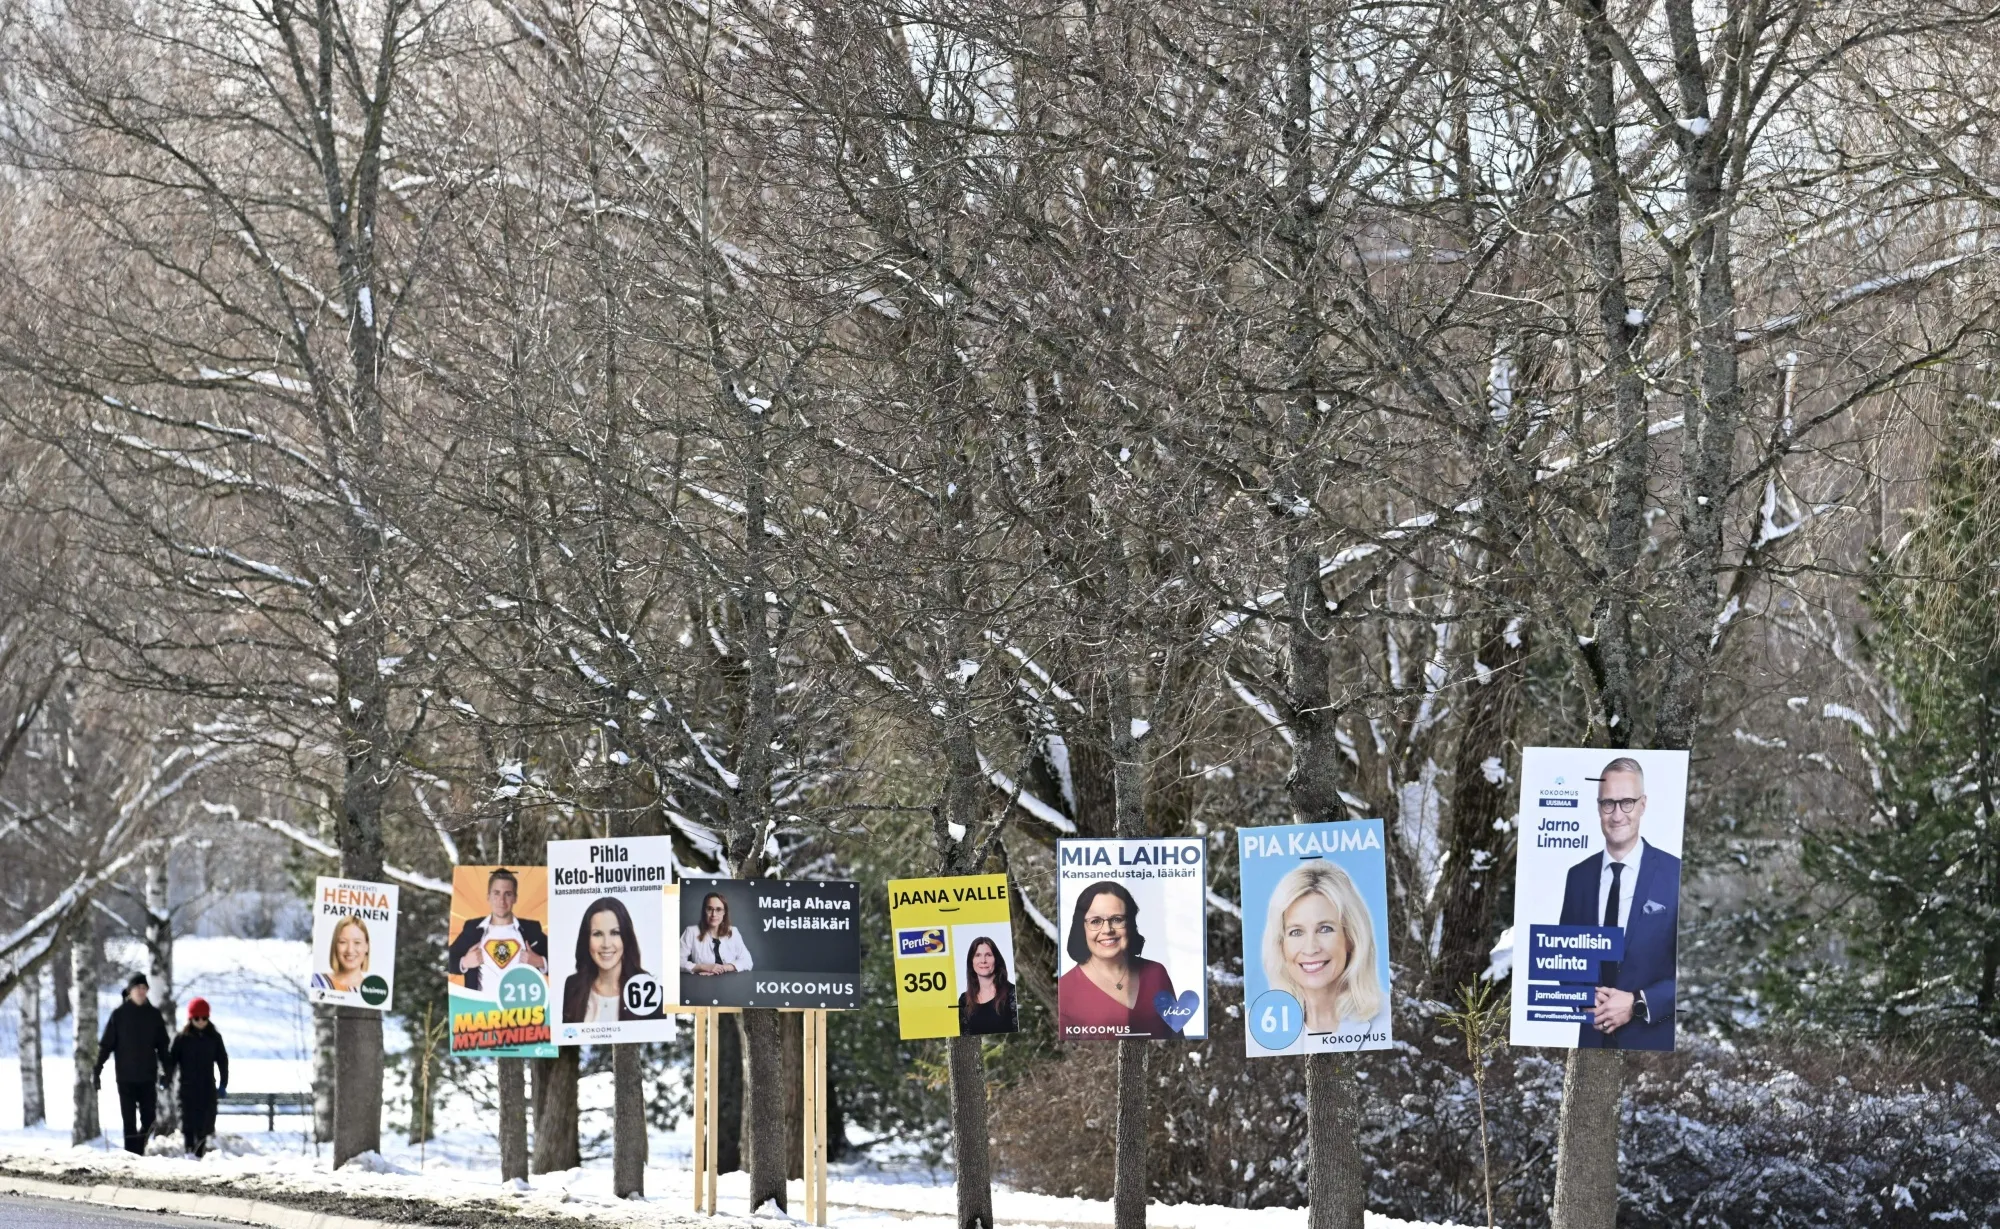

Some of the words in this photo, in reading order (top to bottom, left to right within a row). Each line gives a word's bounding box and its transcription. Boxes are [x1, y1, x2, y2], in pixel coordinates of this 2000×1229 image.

[1545, 799, 1572, 807] UUSIMAA
[1538, 817, 1580, 832] Jarno
[1244, 834, 1285, 859] PIA
[1288, 827, 1381, 856] KAUMA
[1537, 833, 1589, 849] Limnell
[590, 844, 629, 863] Pihla
[1061, 846, 1112, 867] MIA
[1118, 845, 1201, 866] LAIHO
[554, 864, 666, 885] Keto-Huovinen
[1062, 868, 1155, 881] Kansanedustaja,
[1157, 867, 1197, 879] lääkäri
[338, 882, 378, 893] ARKKITEHTI
[554, 886, 603, 896] kansanedustaja,
[323, 886, 389, 909] HENNA
[758, 895, 801, 912] Marja
[804, 897, 851, 910] Ahava
[892, 888, 950, 910] JAANA
[953, 885, 1007, 903] VALLE
[323, 903, 390, 922] PARTANEN
[763, 916, 850, 932] yleislääkäri
[1536, 932, 1612, 950] Turvallisin
[1536, 953, 1588, 971] valinta
[756, 981, 854, 996] KOKOOMUS
[904, 971, 947, 993] 350
[503, 983, 542, 1002] 219
[627, 980, 658, 1009] 62
[1534, 990, 1588, 1001] jarnolimnell.fi
[453, 1005, 546, 1033] MARKUS
[1260, 1005, 1290, 1034] 61
[453, 1024, 551, 1051] MYLLYNIEM
[581, 1026, 622, 1034] KOKOOMUS
[1065, 1025, 1131, 1035] KOKOOMUS
[1322, 1032, 1387, 1045] KOKOOMUS
